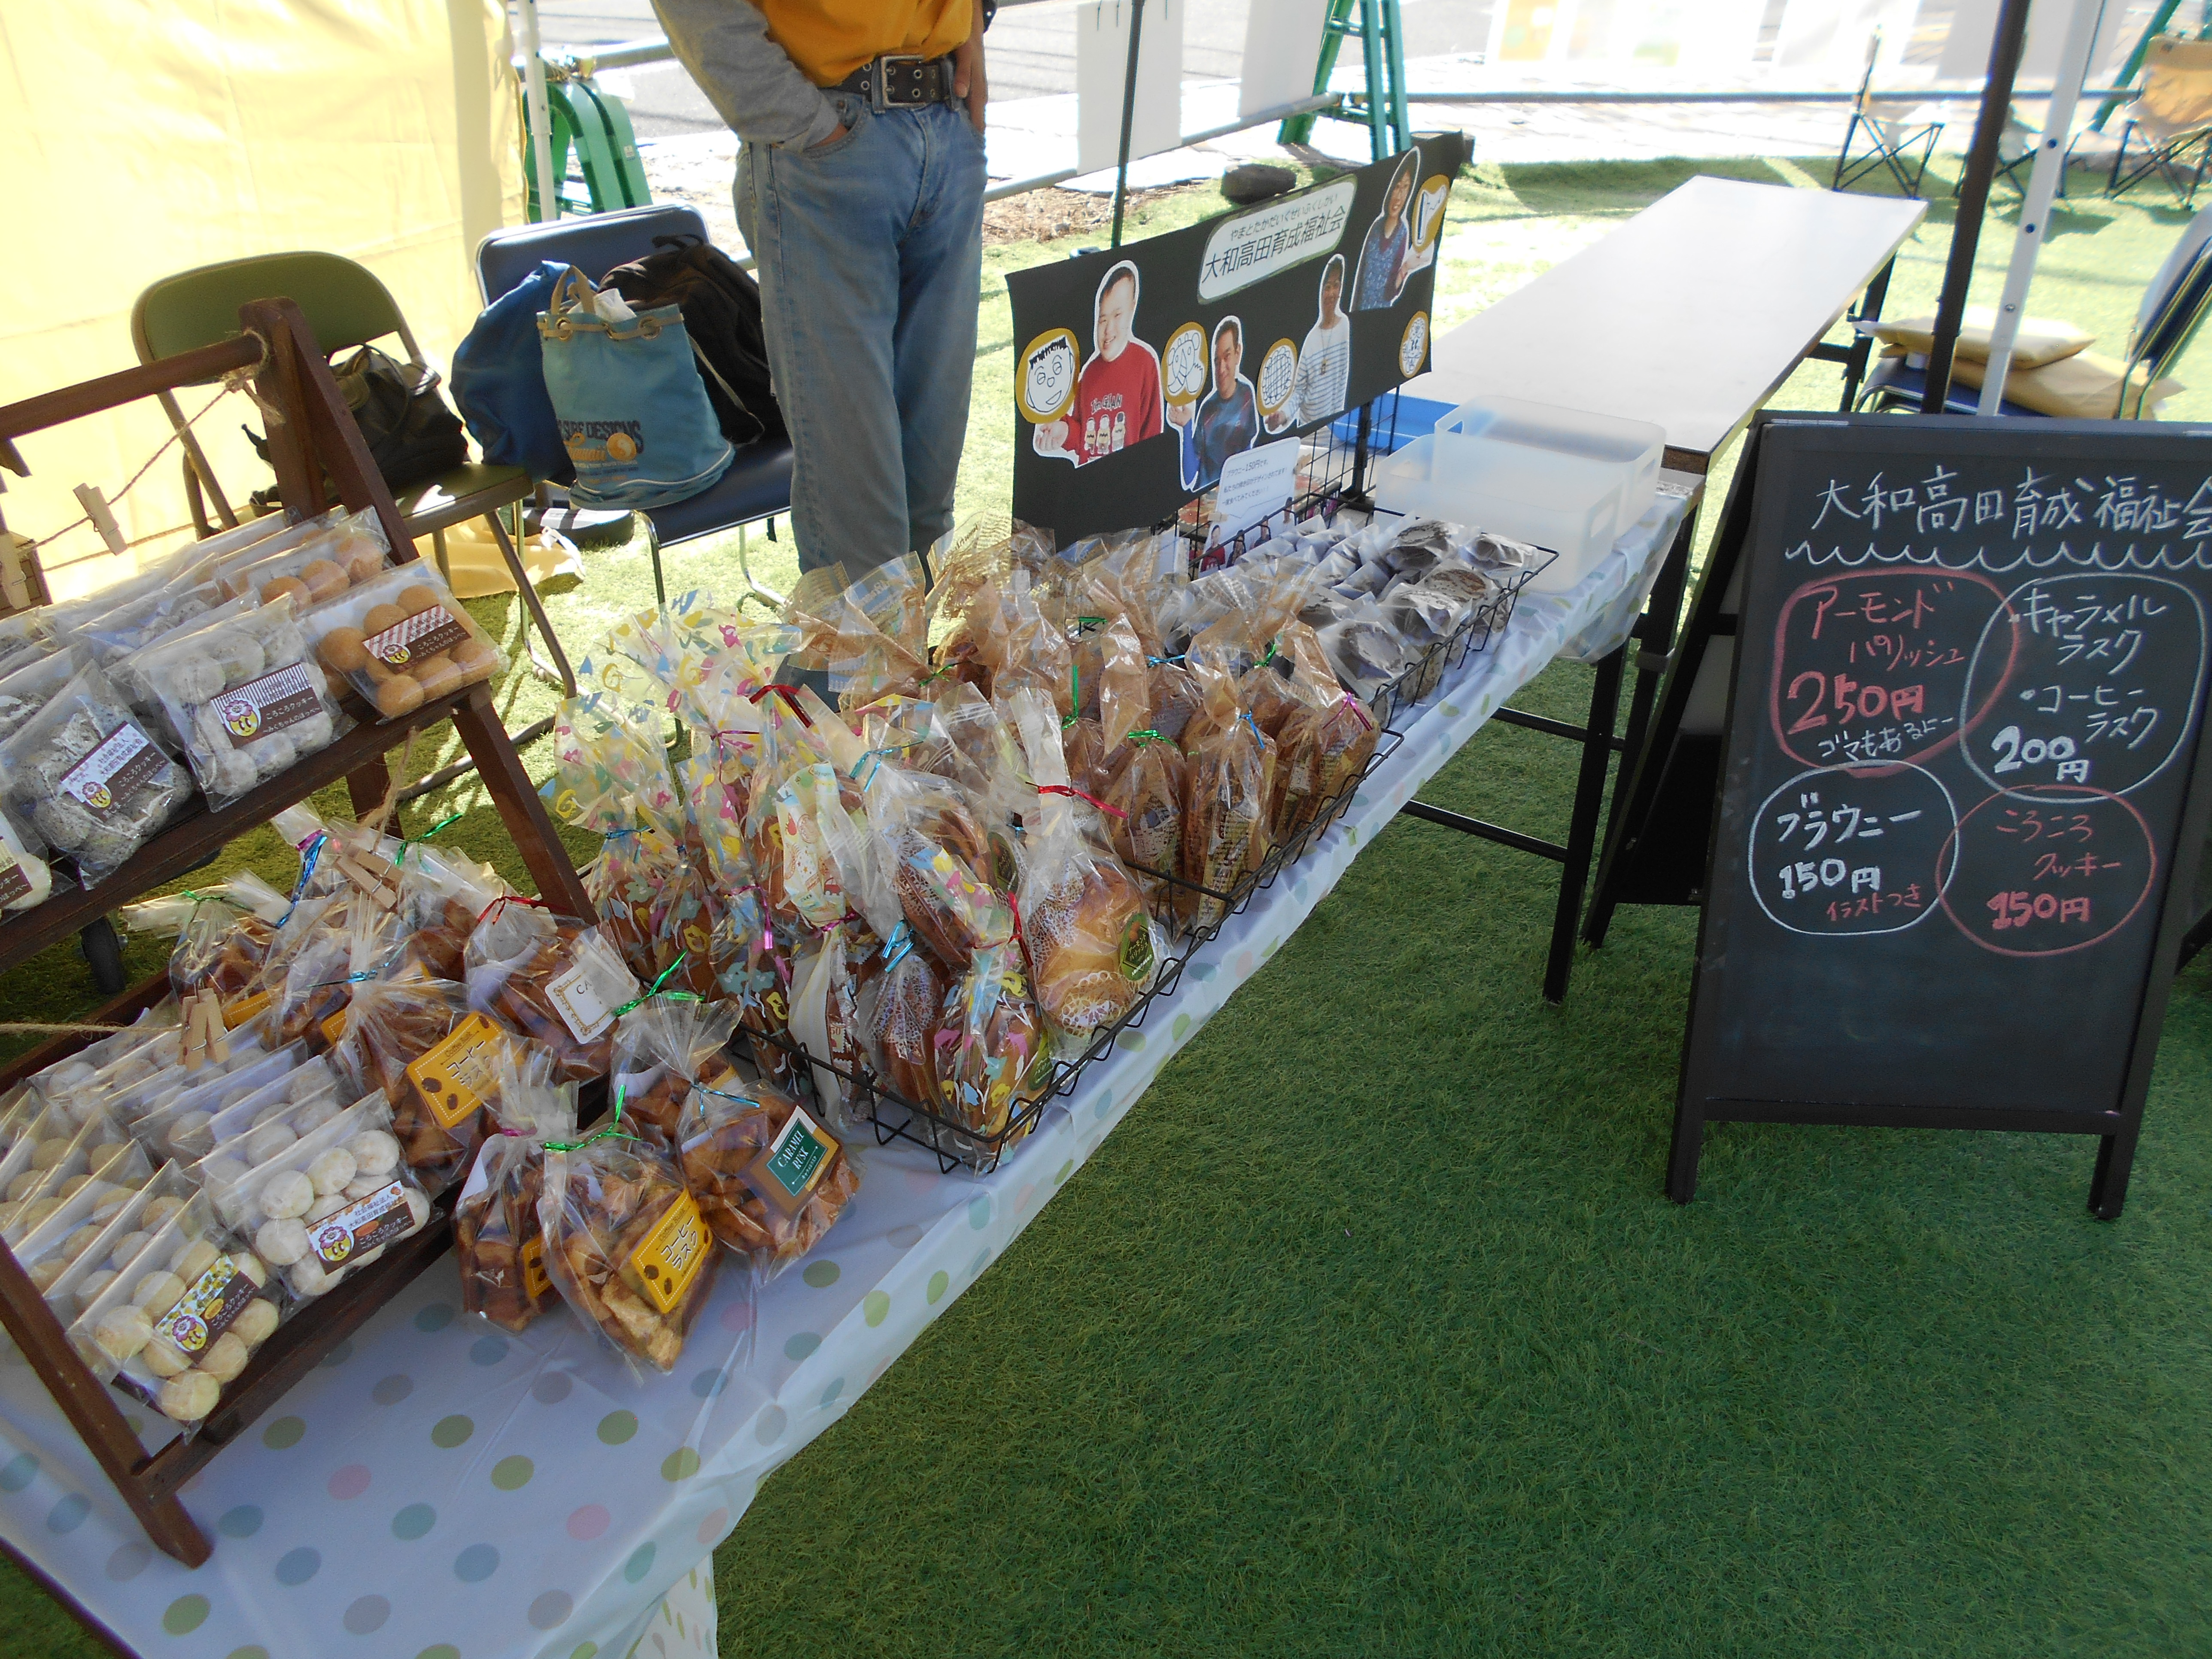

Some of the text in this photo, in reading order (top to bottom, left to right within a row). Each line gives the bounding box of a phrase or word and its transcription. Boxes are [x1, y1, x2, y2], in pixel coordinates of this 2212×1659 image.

[1202, 205, 1346, 284] 大和高田育成福祉会
[1800, 582, 1954, 640] アーモンド
[1849, 634, 1966, 671] パリッシュ
[2057, 629, 2143, 676] ラスク
[265, 696, 313, 720] ころころクッキー
[1787, 671, 1925, 735] 250円
[2085, 706, 2159, 750] ラスク
[1991, 725, 2090, 784] 200円
[1777, 792, 1923, 851] ブラウニー
[1996, 809, 2094, 842] ころころ
[1779, 857, 1881, 899] 150円
[2033, 851, 2121, 881] クッキー
[1825, 883, 1922, 922] イラストつき
[1986, 891, 2091, 930] 150円
[446, 1040, 486, 1079] コーヒー
[777, 1130, 805, 1168] CARAMEL
[792, 1146, 809, 1170] RUSK
[354, 1194, 393, 1217] 社会福祉法人
[359, 1215, 408, 1245] ころころクッキー
[660, 1215, 695, 1263] コーヒー
[672, 1230, 698, 1271] ラスク
